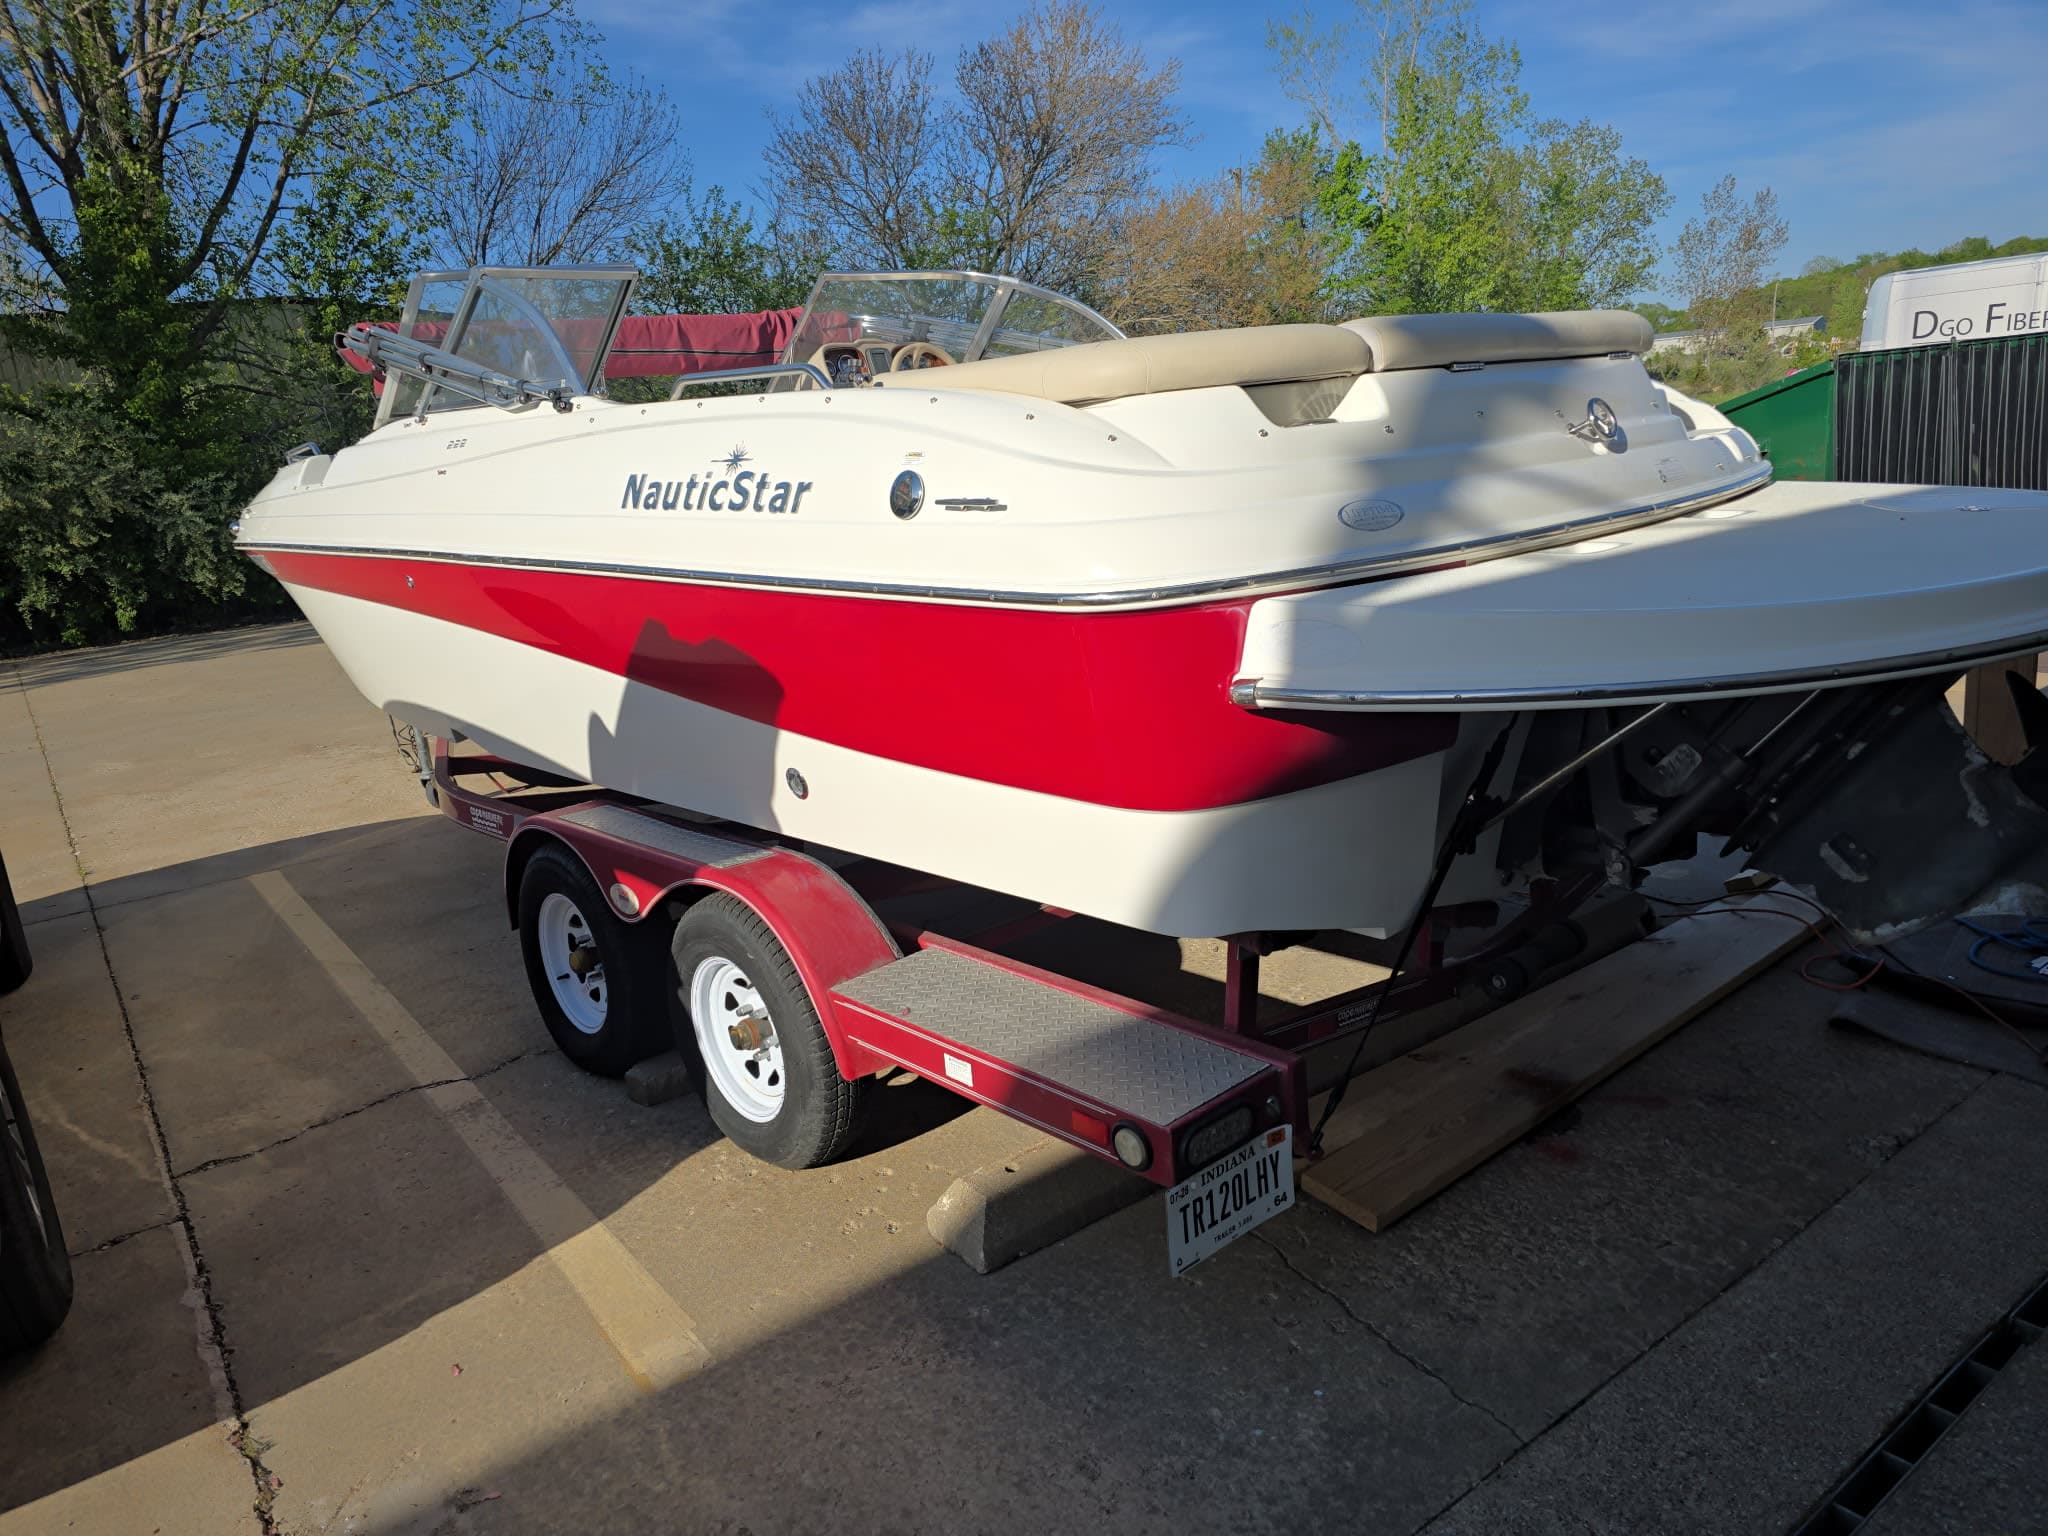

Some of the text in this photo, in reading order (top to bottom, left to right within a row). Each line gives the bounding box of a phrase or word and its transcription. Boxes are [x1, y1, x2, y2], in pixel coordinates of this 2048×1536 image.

[621, 471, 814, 514] NauticStar
[1200, 1146, 1256, 1187] INDIANA
[1179, 1151, 1280, 1244] TR120LHY
[1273, 1191, 1288, 1207] 64
[1214, 1225, 1236, 1243] TRAILER
